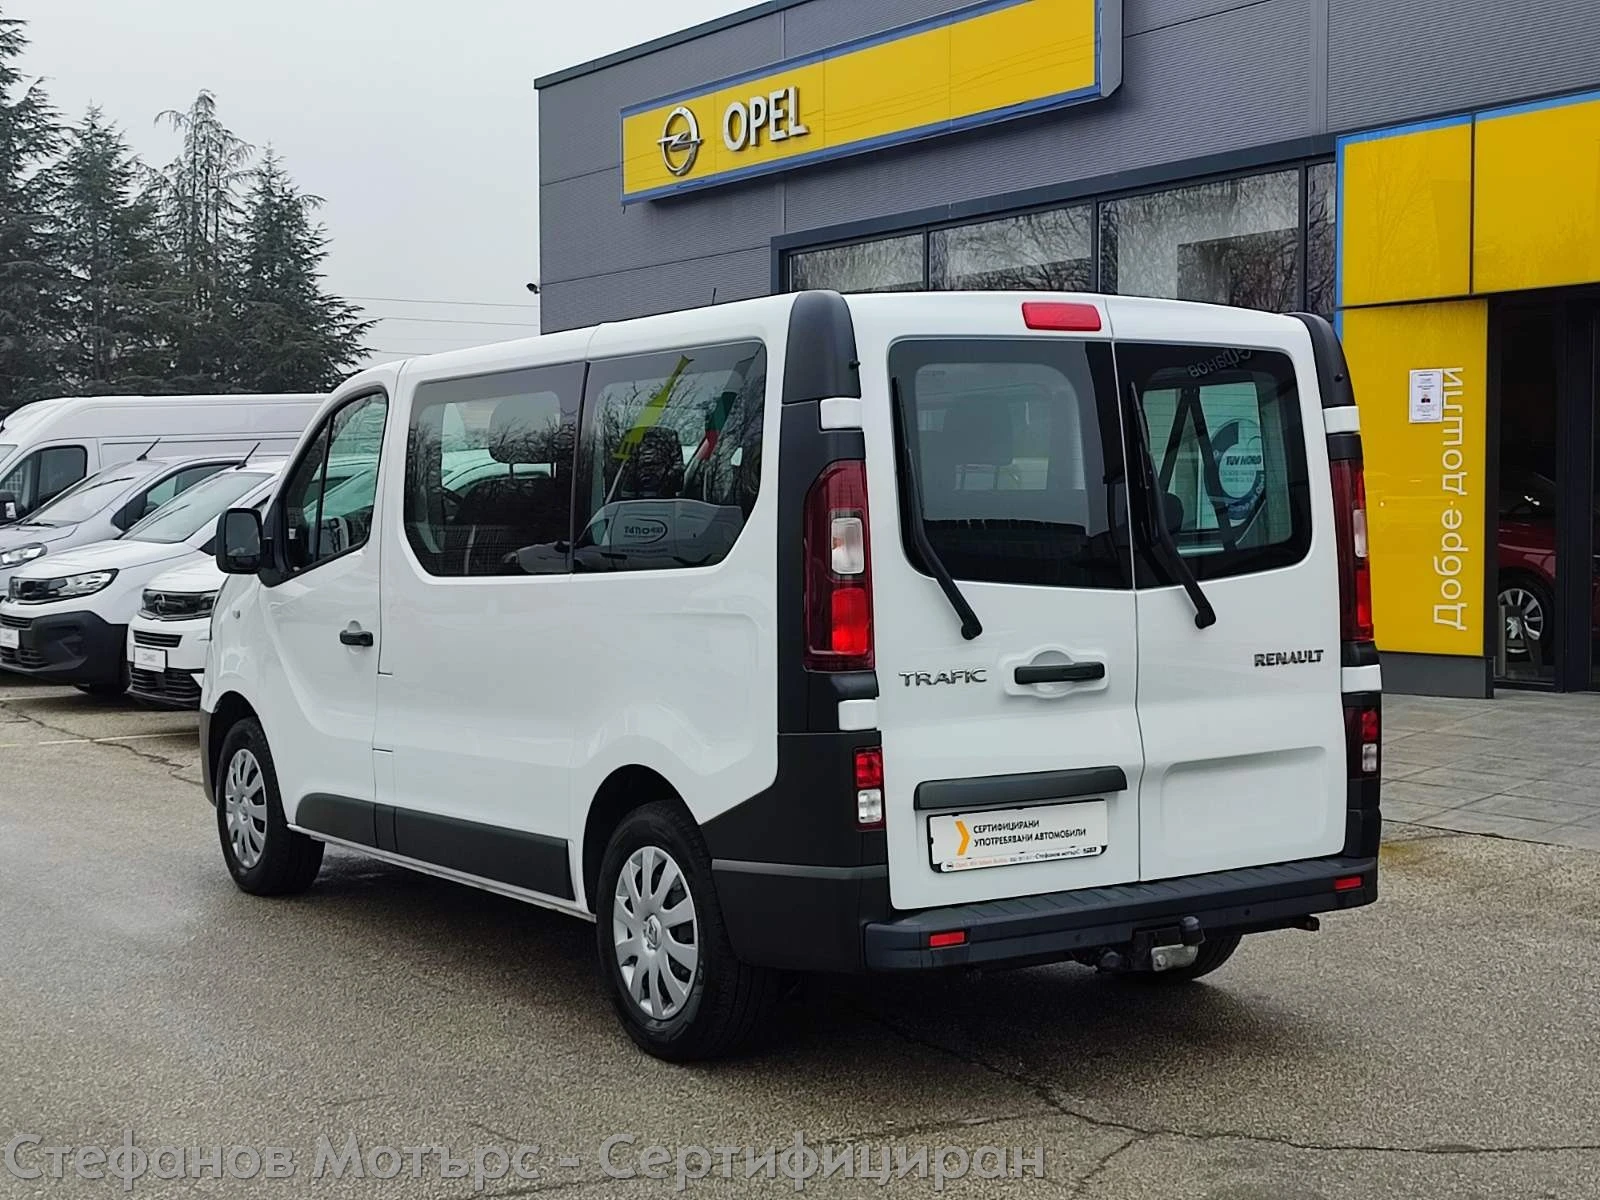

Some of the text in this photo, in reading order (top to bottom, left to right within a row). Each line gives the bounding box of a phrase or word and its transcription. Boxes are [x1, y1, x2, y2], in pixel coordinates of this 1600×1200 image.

[722, 86, 809, 151] OPEL
[1433, 367, 1468, 631] Добре дошли
[1254, 649, 1324, 667] RENAULT
[898, 668, 987, 687] TRAFIC
[973, 820, 1040, 834] СЕРТИФИЦИРАНИ
[974, 828, 1086, 848] УПОТРЕБЯВАНИ АВТОМОБИЛИ
